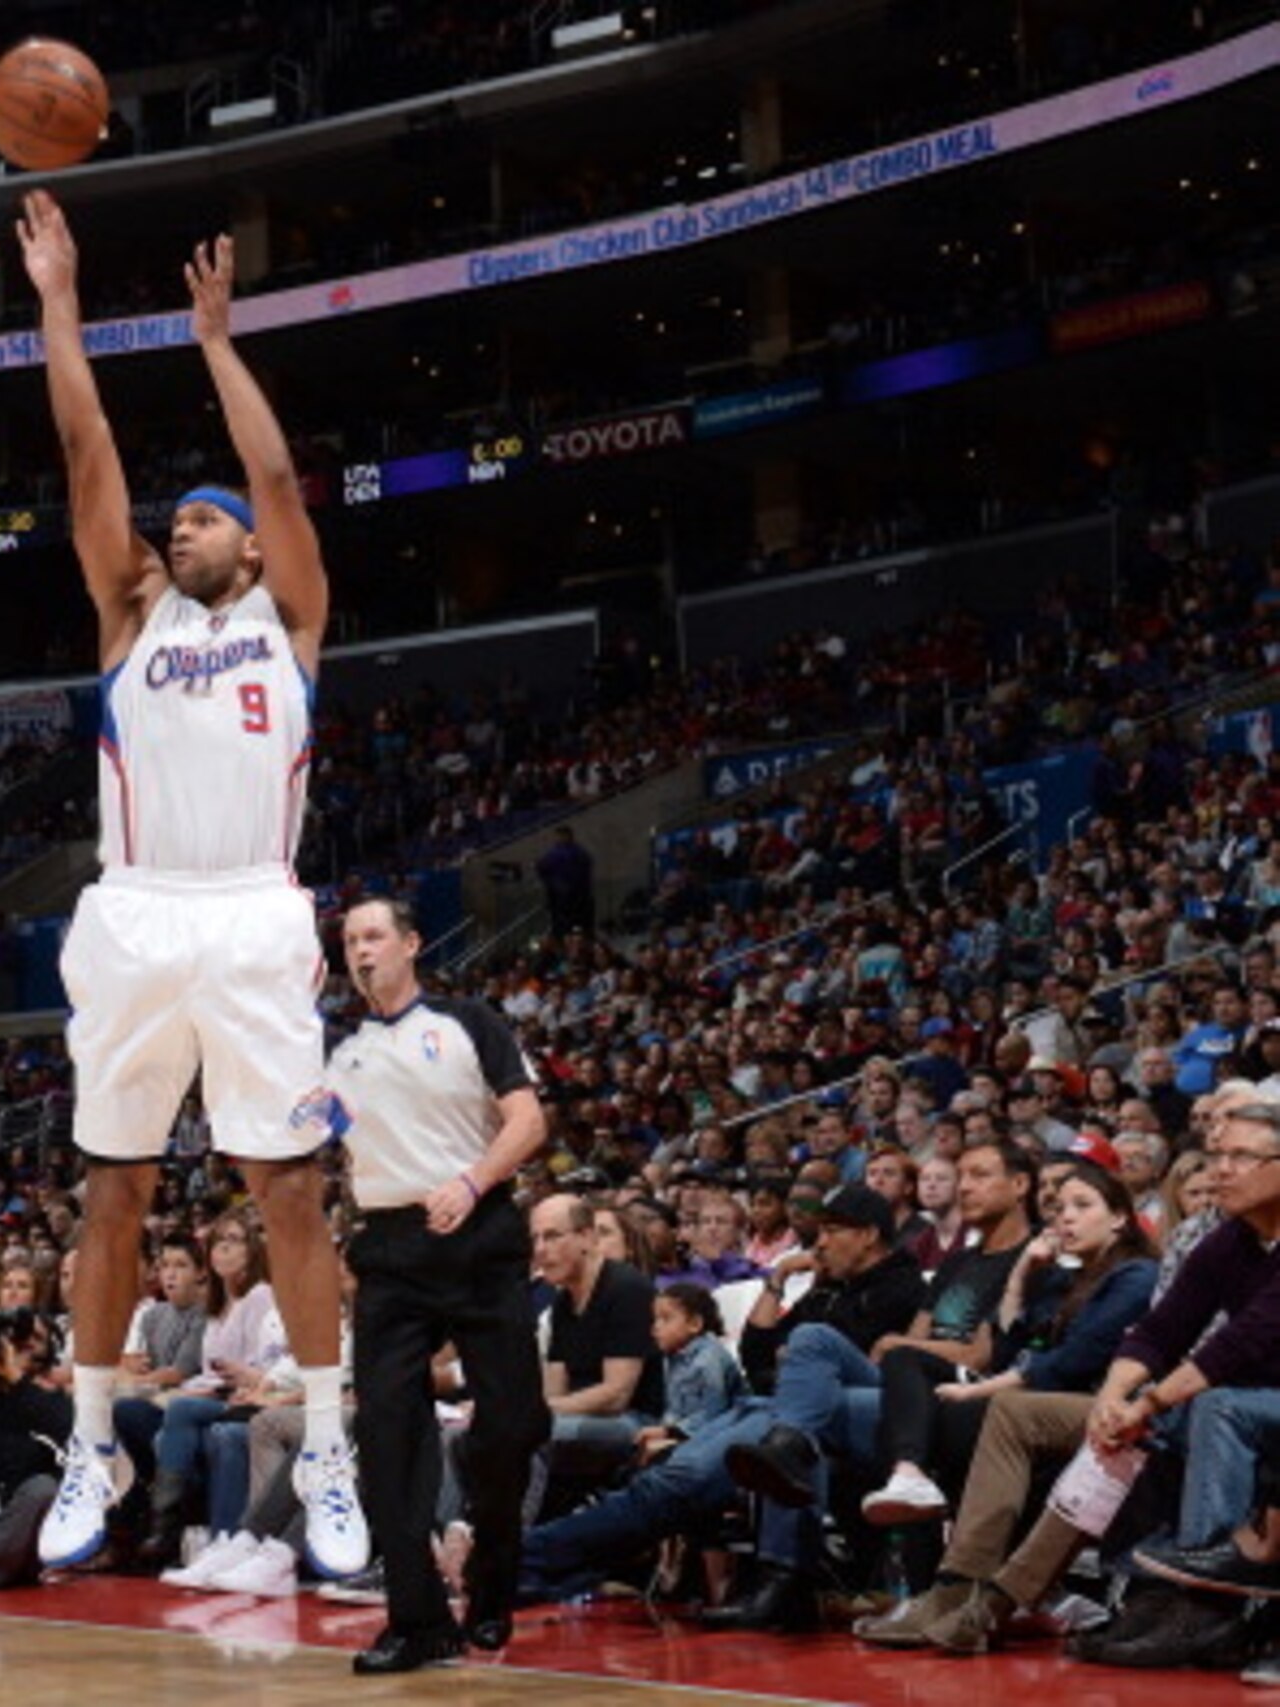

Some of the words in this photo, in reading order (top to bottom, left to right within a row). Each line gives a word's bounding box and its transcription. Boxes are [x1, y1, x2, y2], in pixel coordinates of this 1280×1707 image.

[468, 248, 554, 288] Clippers
[558, 229, 646, 265] Chicken
[650, 211, 698, 250] Club
[703, 187, 801, 235] Sandwich
[853, 142, 931, 191] COMBO
[936, 122, 997, 164] MEAL
[542, 413, 686, 463] TOYOTA
[343, 481, 381, 506] DEN
[145, 635, 274, 696] Clippers
[238, 683, 271, 734] 9
